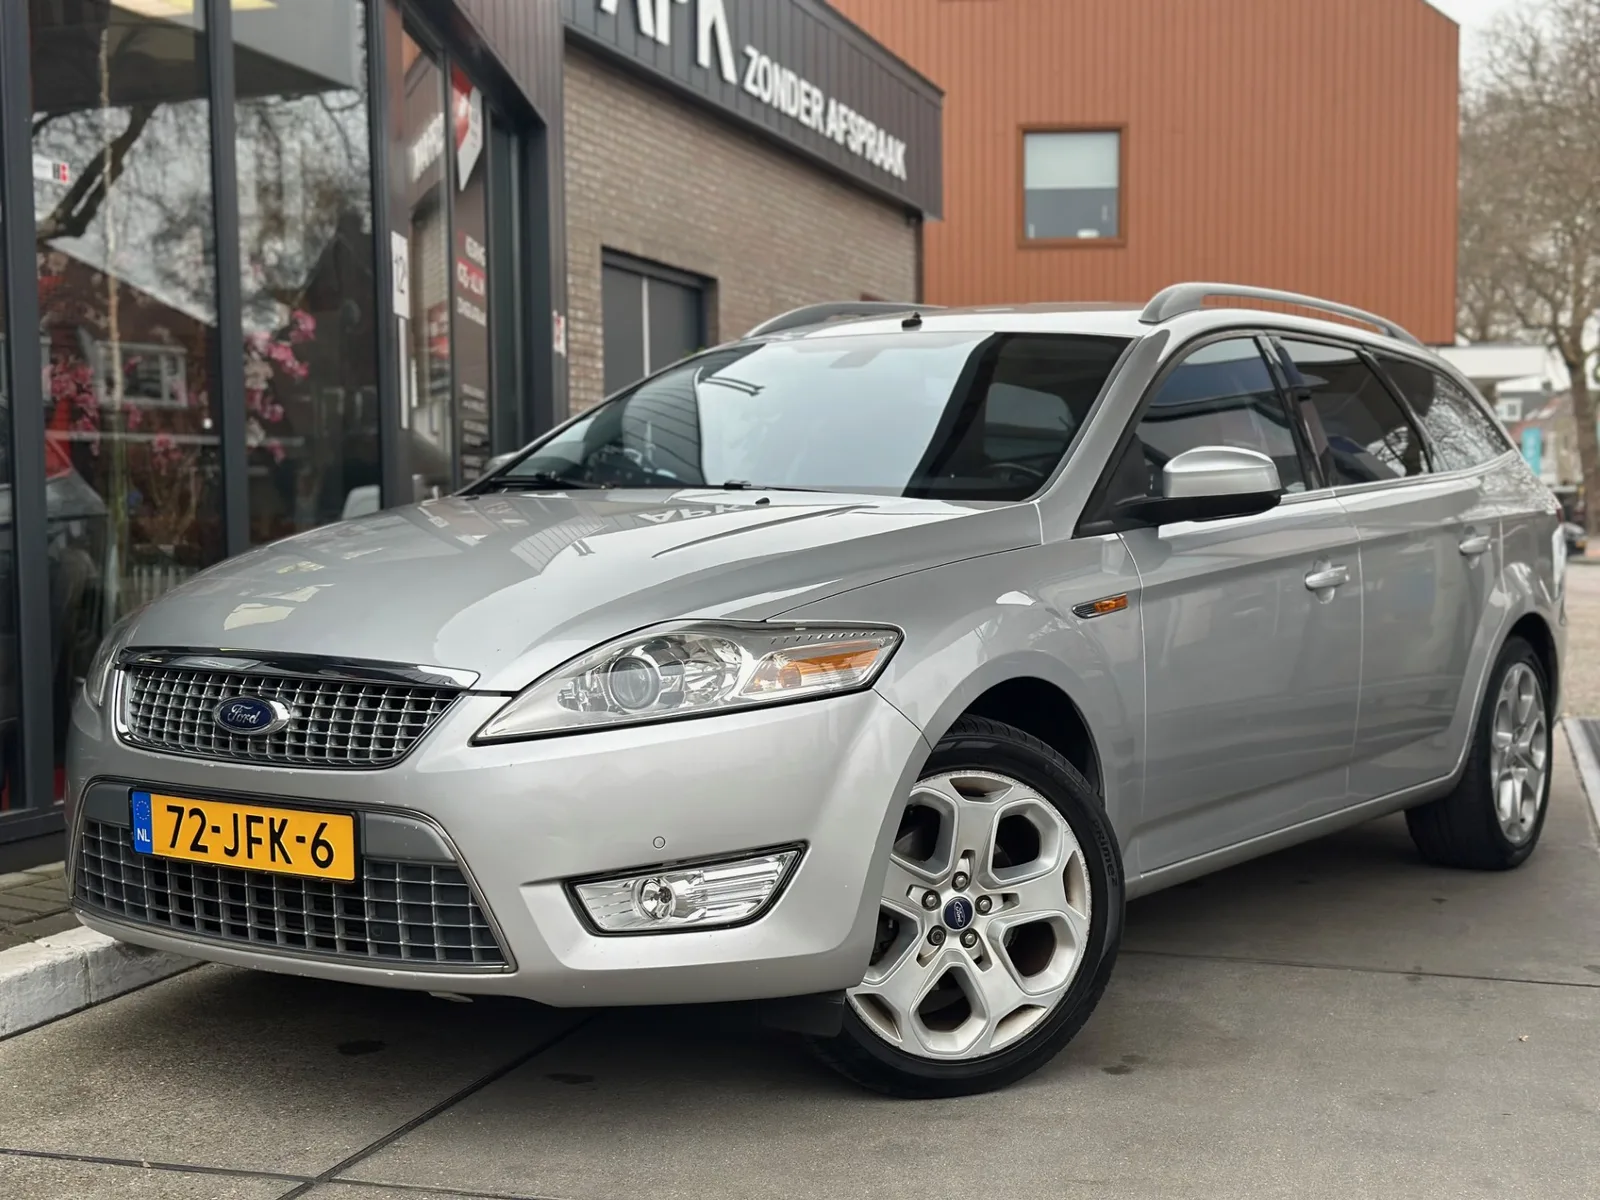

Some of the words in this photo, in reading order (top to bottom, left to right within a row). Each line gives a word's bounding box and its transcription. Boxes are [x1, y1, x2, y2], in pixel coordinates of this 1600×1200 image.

[744, 45, 825, 134] ZONDER
[825, 97, 907, 181] AFSPRAAK
[227, 703, 260, 724] Ford
[137, 828, 150, 842] NL
[166, 805, 334, 869] 72-JFK-6
